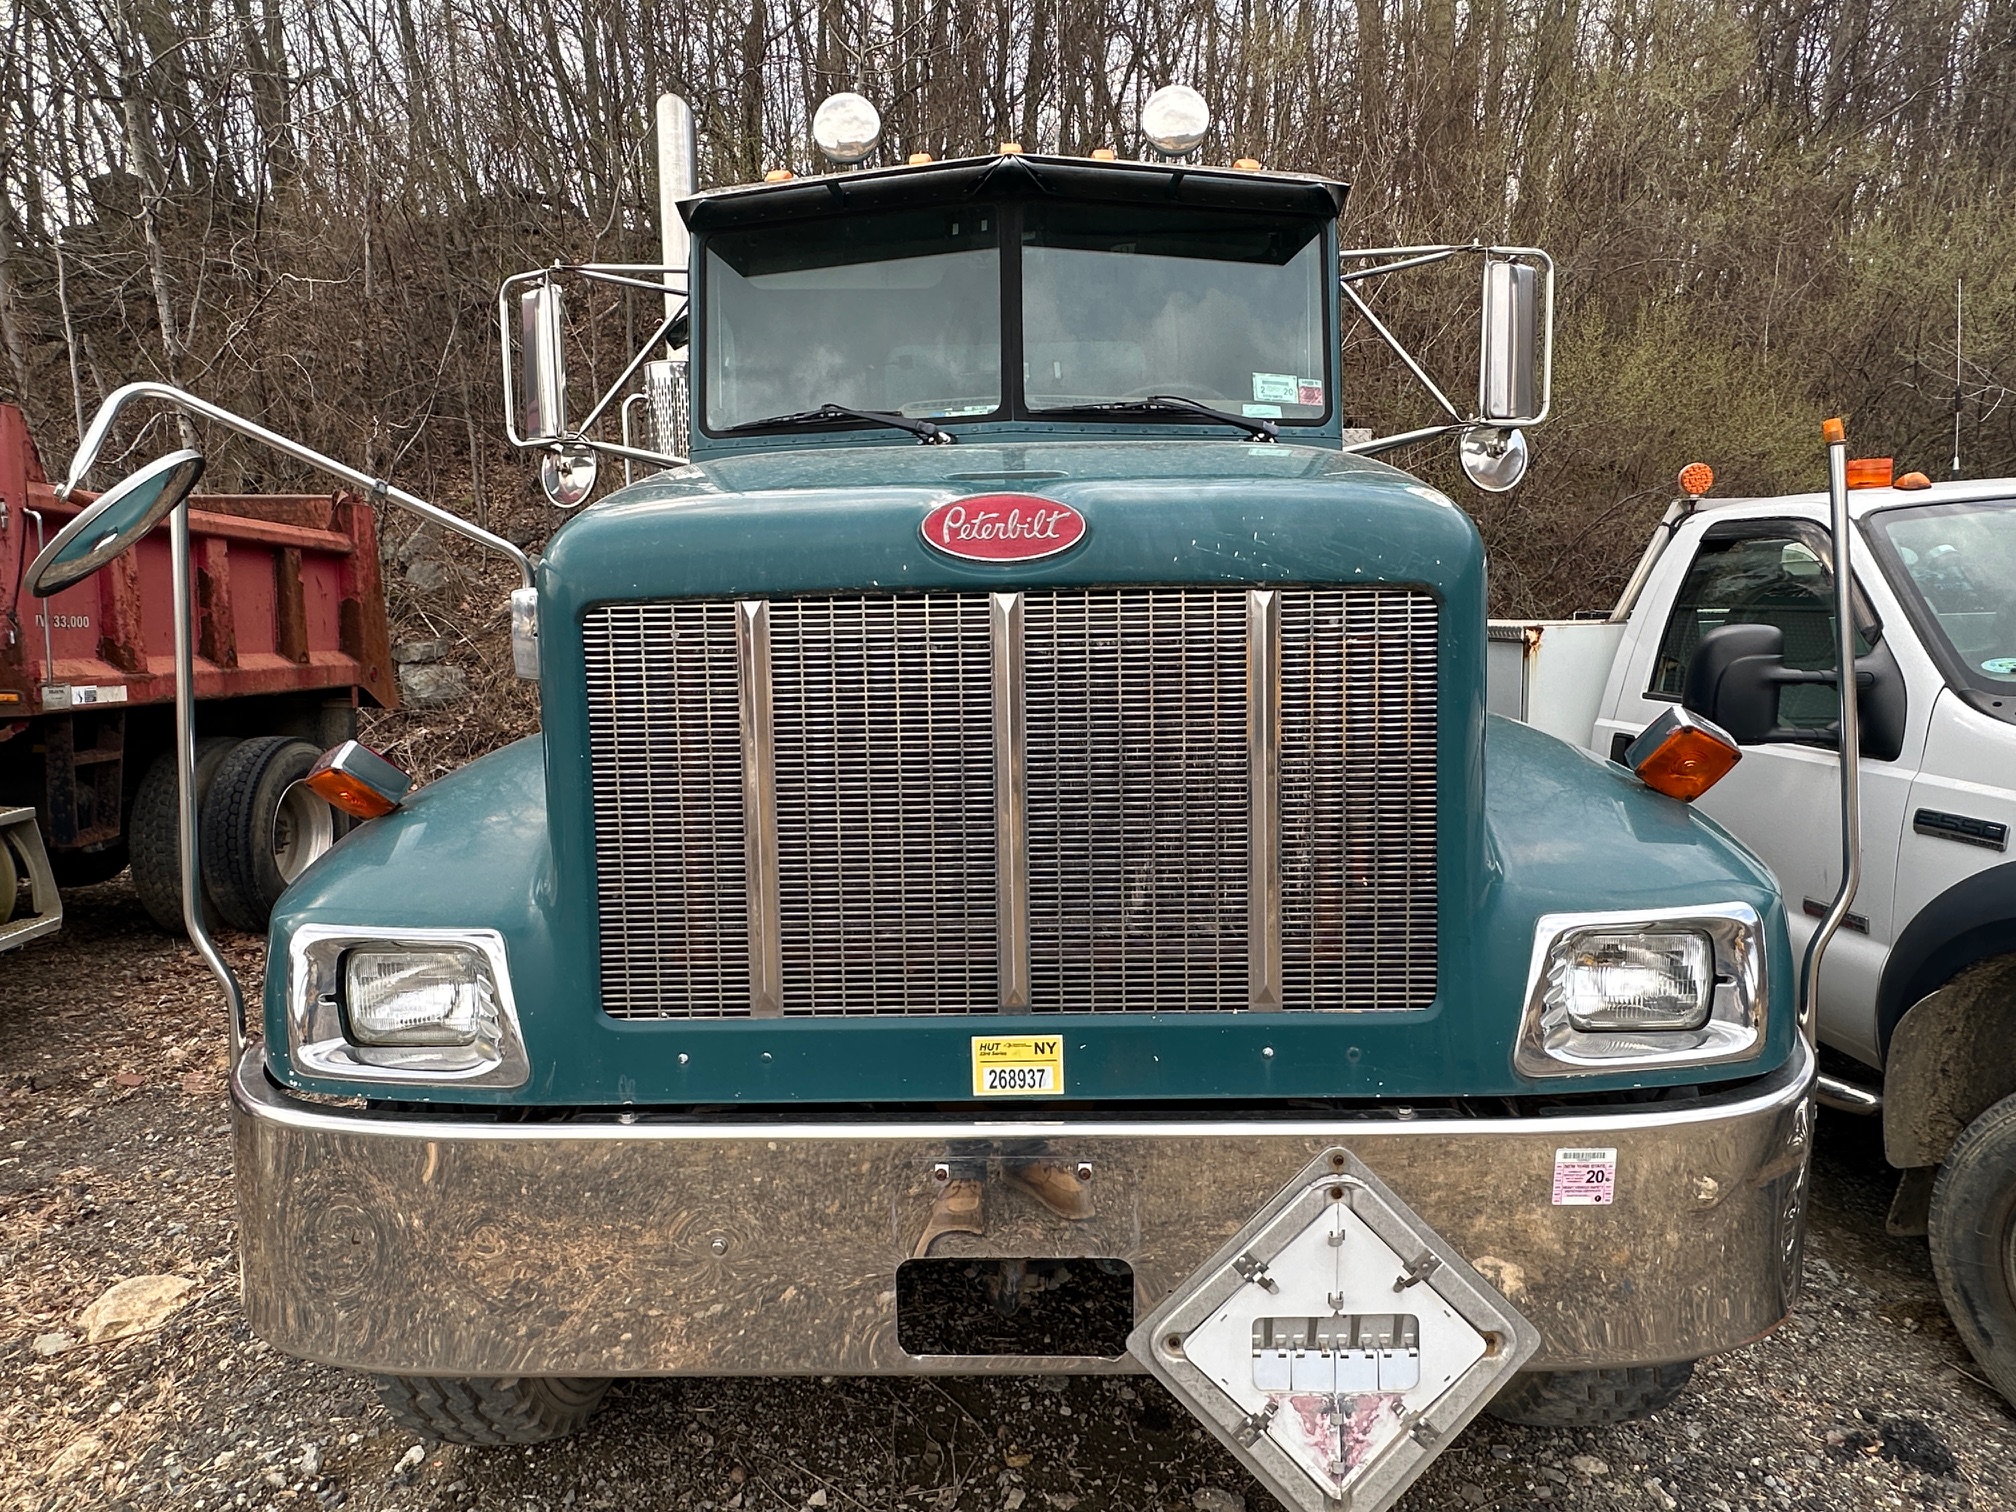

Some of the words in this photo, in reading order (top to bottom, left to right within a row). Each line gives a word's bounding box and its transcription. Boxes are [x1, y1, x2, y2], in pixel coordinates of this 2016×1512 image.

[943, 506, 1071, 544] Peterbilt
[53, 614, 90, 629] 33,000
[979, 1043, 1001, 1052] HUT
[1034, 1042, 1057, 1055] NY
[989, 1069, 1046, 1090] 268937
[1586, 1170, 1604, 1183] 20
